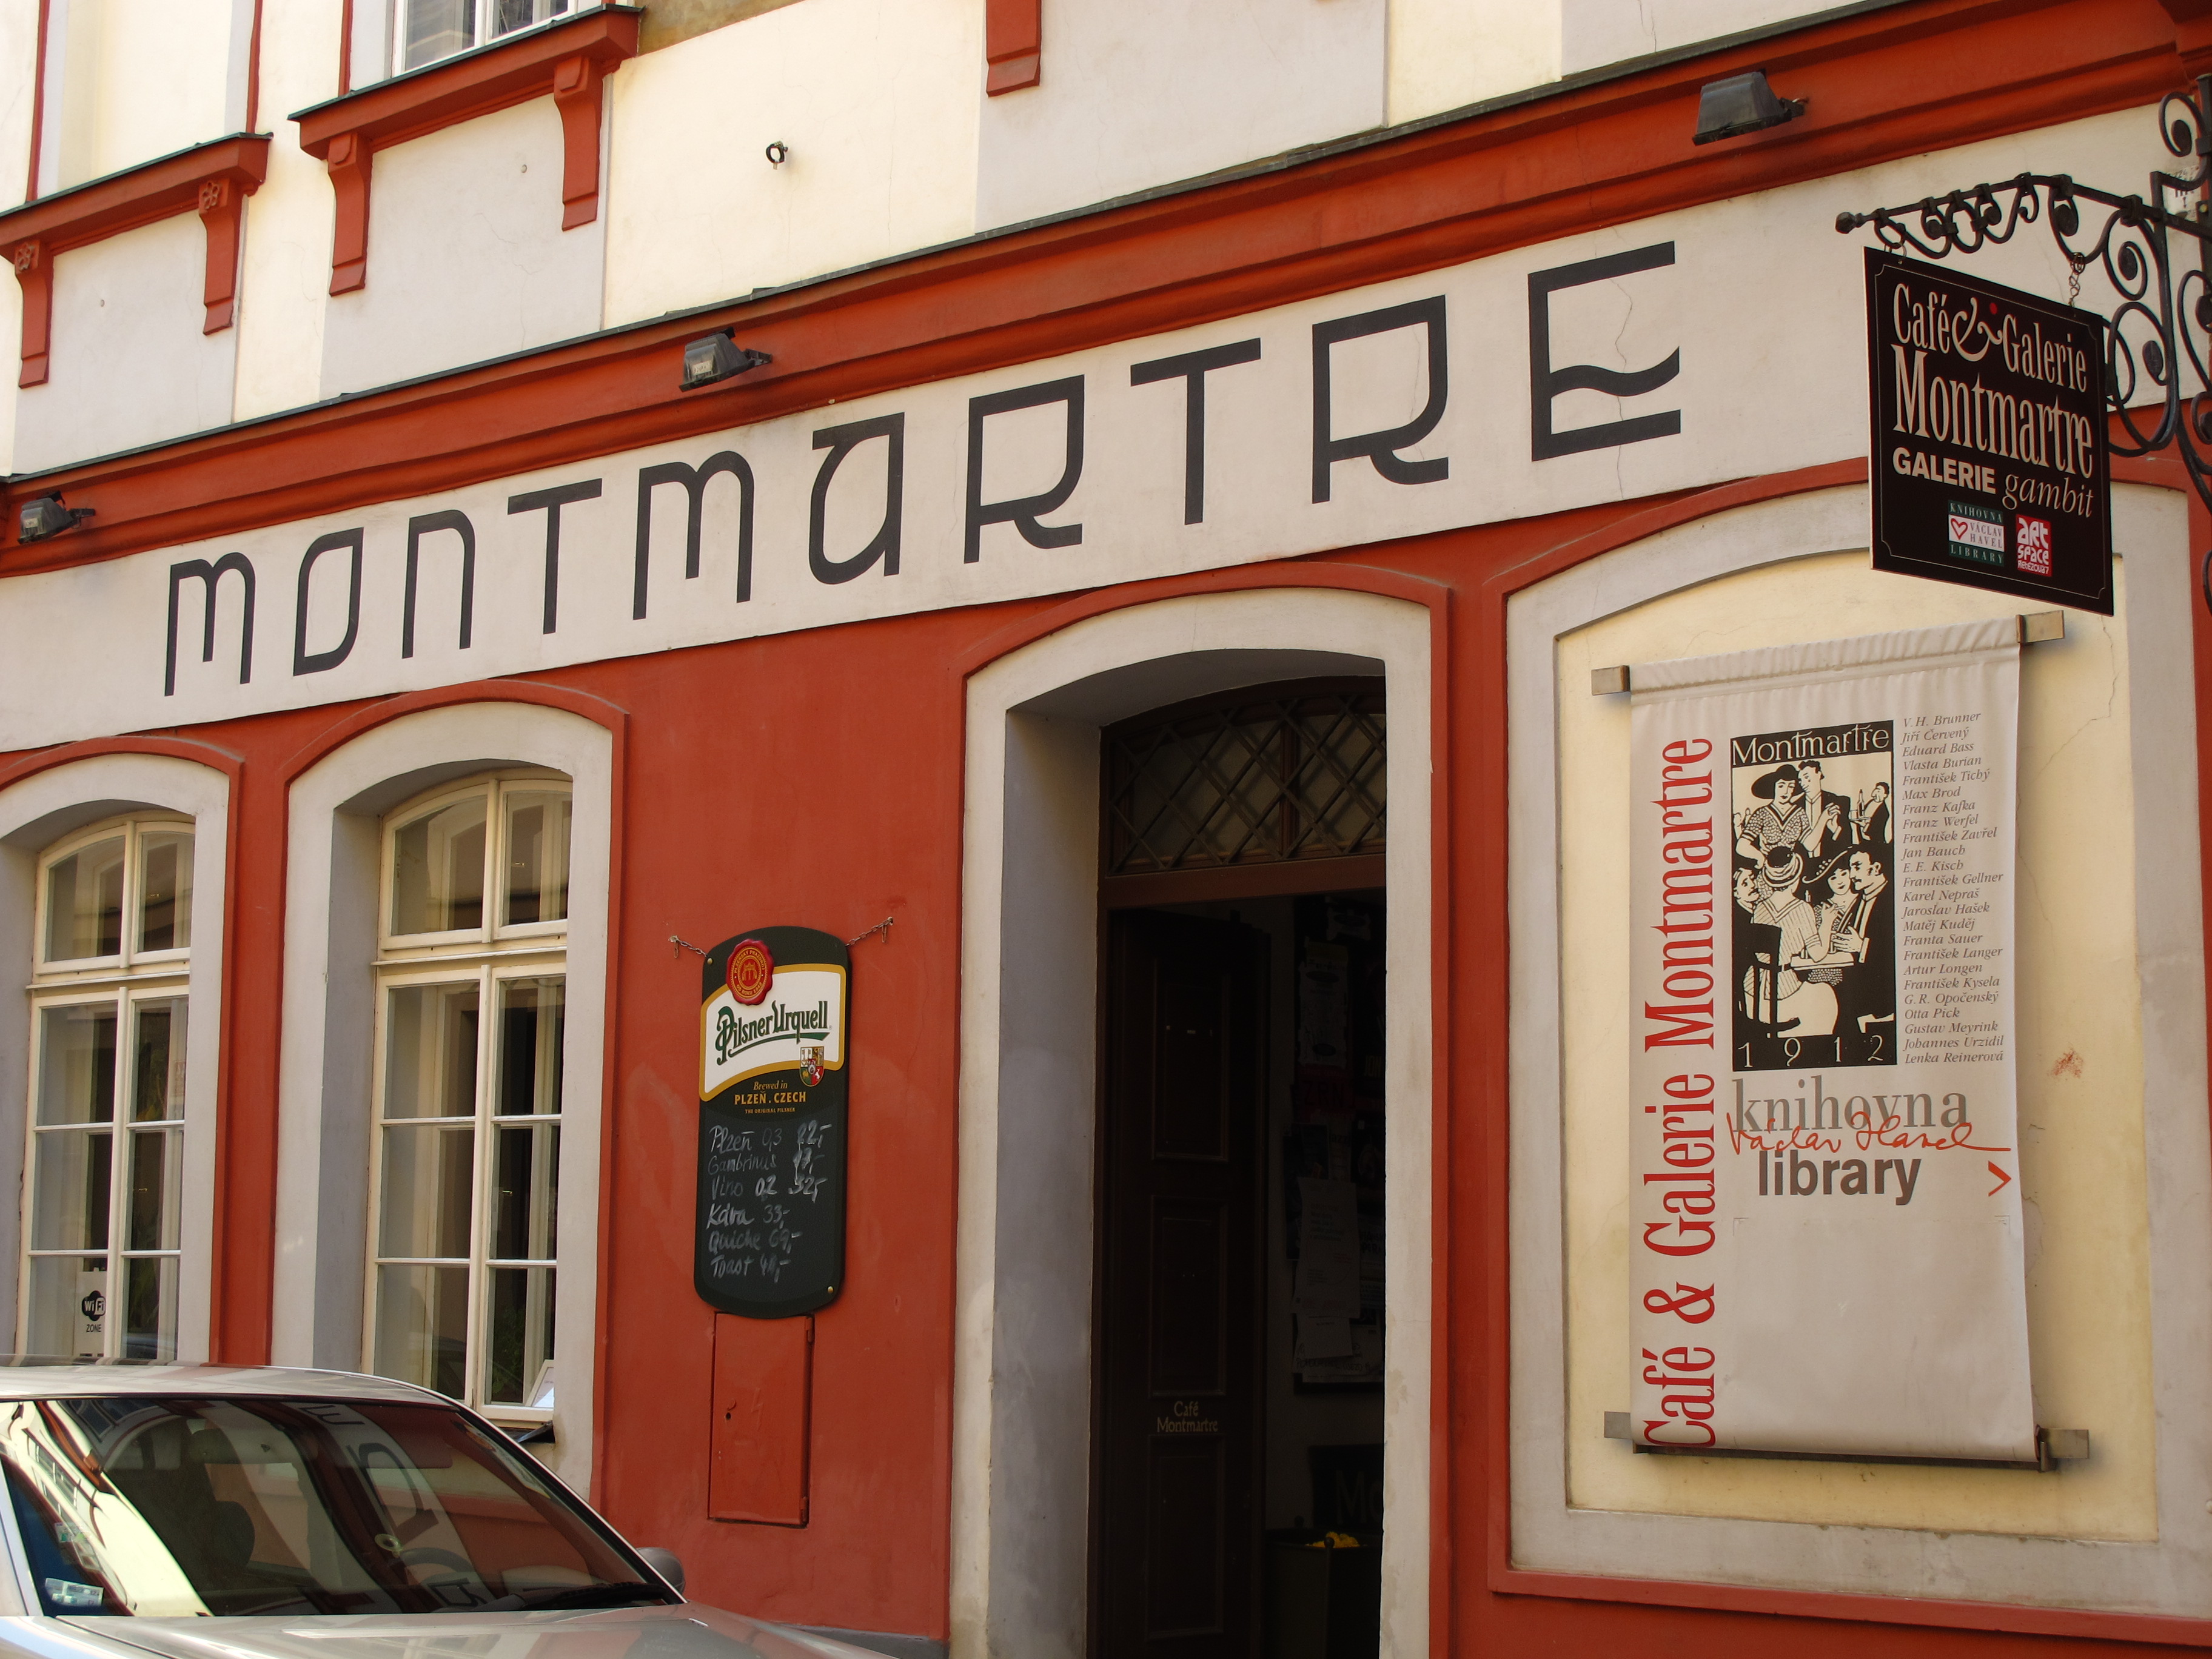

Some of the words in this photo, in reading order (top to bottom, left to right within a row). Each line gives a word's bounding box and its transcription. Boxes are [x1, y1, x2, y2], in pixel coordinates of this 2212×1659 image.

[1893, 283, 1949, 354] Café
[1951, 297, 2003, 361] &
[2003, 314, 2086, 393] Galerie
[1890, 344, 2093, 478] Montmartre
[1892, 447, 1996, 494] GALERIE
[2002, 472, 2094, 518] gambit
[1950, 503, 2002, 523] KNIHOVNA
[1970, 522, 2002, 537] VÁCLAV
[1970, 534, 2003, 548] HAVEL
[1951, 545, 2003, 563] LIBRARY
[1934, 713, 1981, 725] Brunner
[1900, 731, 1920, 745] Jiří
[1924, 727, 1969, 740] Červený
[1732, 723, 1889, 766] Montmartre
[1903, 743, 1946, 757] Eduard
[1950, 743, 1974, 753] Bass
[1904, 761, 1938, 770] Vlasta
[1943, 757, 1981, 768] Burian
[1903, 772, 1956, 786] František
[1960, 768, 1989, 782] Tichý
[1902, 790, 1927, 800] Max
[1932, 786, 1960, 798] Brod
[1903, 805, 1938, 814] Franz
[1942, 800, 1975, 814] Kafka
[1903, 819, 1938, 829] Franz
[1943, 814, 1979, 828] Werfel
[1903, 831, 1957, 843] František
[1961, 827, 1997, 840] Zavřel
[1901, 848, 1922, 860] Jan
[1927, 845, 1965, 857] Bauch
[1931, 860, 1963, 871] Kisch
[1903, 875, 1958, 887] František
[1962, 873, 2003, 884] Gellner
[1644, 738, 1715, 1053] Montmartre
[1903, 890, 1935, 902] Karel
[1939, 888, 1980, 902] Nepraš
[1901, 905, 1951, 919] Jaroslav
[1956, 902, 1989, 914] Hašek
[1903, 920, 1936, 933] Matěj
[1940, 918, 1976, 931] Kuděj
[1903, 936, 1943, 945] Franta
[1948, 934, 1983, 944] Sauer
[1903, 948, 1959, 960] František
[1963, 948, 2003, 960] Langer
[1903, 965, 1936, 975] Artur
[1939, 964, 1983, 976] Longen
[1904, 977, 1959, 990] František
[1963, 976, 2000, 990] Kysela
[1936, 991, 1999, 1006] Opočenský
[1905, 1010, 1928, 1019] Otta
[1933, 1007, 1960, 1018] Pick
[715, 1006, 774, 1065] Pilsner
[771, 1000, 828, 1044] Urquell
[1905, 1024, 1945, 1034] Gustav
[1949, 1021, 1998, 1035] Meyrink
[1903, 1038, 1959, 1051] Johannes
[1964, 1035, 2004, 1047] Urzidil
[1905, 1053, 1939, 1064] Lenka
[1943, 1051, 2003, 1062] Reinerová
[754, 1080, 779, 1090] Brewed
[780, 1080, 788, 1088] in
[774, 1091, 806, 1103] CZECH
[1732, 1075, 1969, 1133] knihovna
[708, 1153, 776, 1175] Gambrinus
[1643, 1073, 1716, 1257] Galerie
[1758, 1149, 1922, 1205] library
[711, 1255, 754, 1278] Toast
[1643, 1281, 1715, 1324] &
[86, 1324, 102, 1333] ZONE
[1643, 1346, 1716, 1448] Café
[1173, 1401, 1199, 1417] Café
[1157, 1416, 1218, 1433] Montmartre
